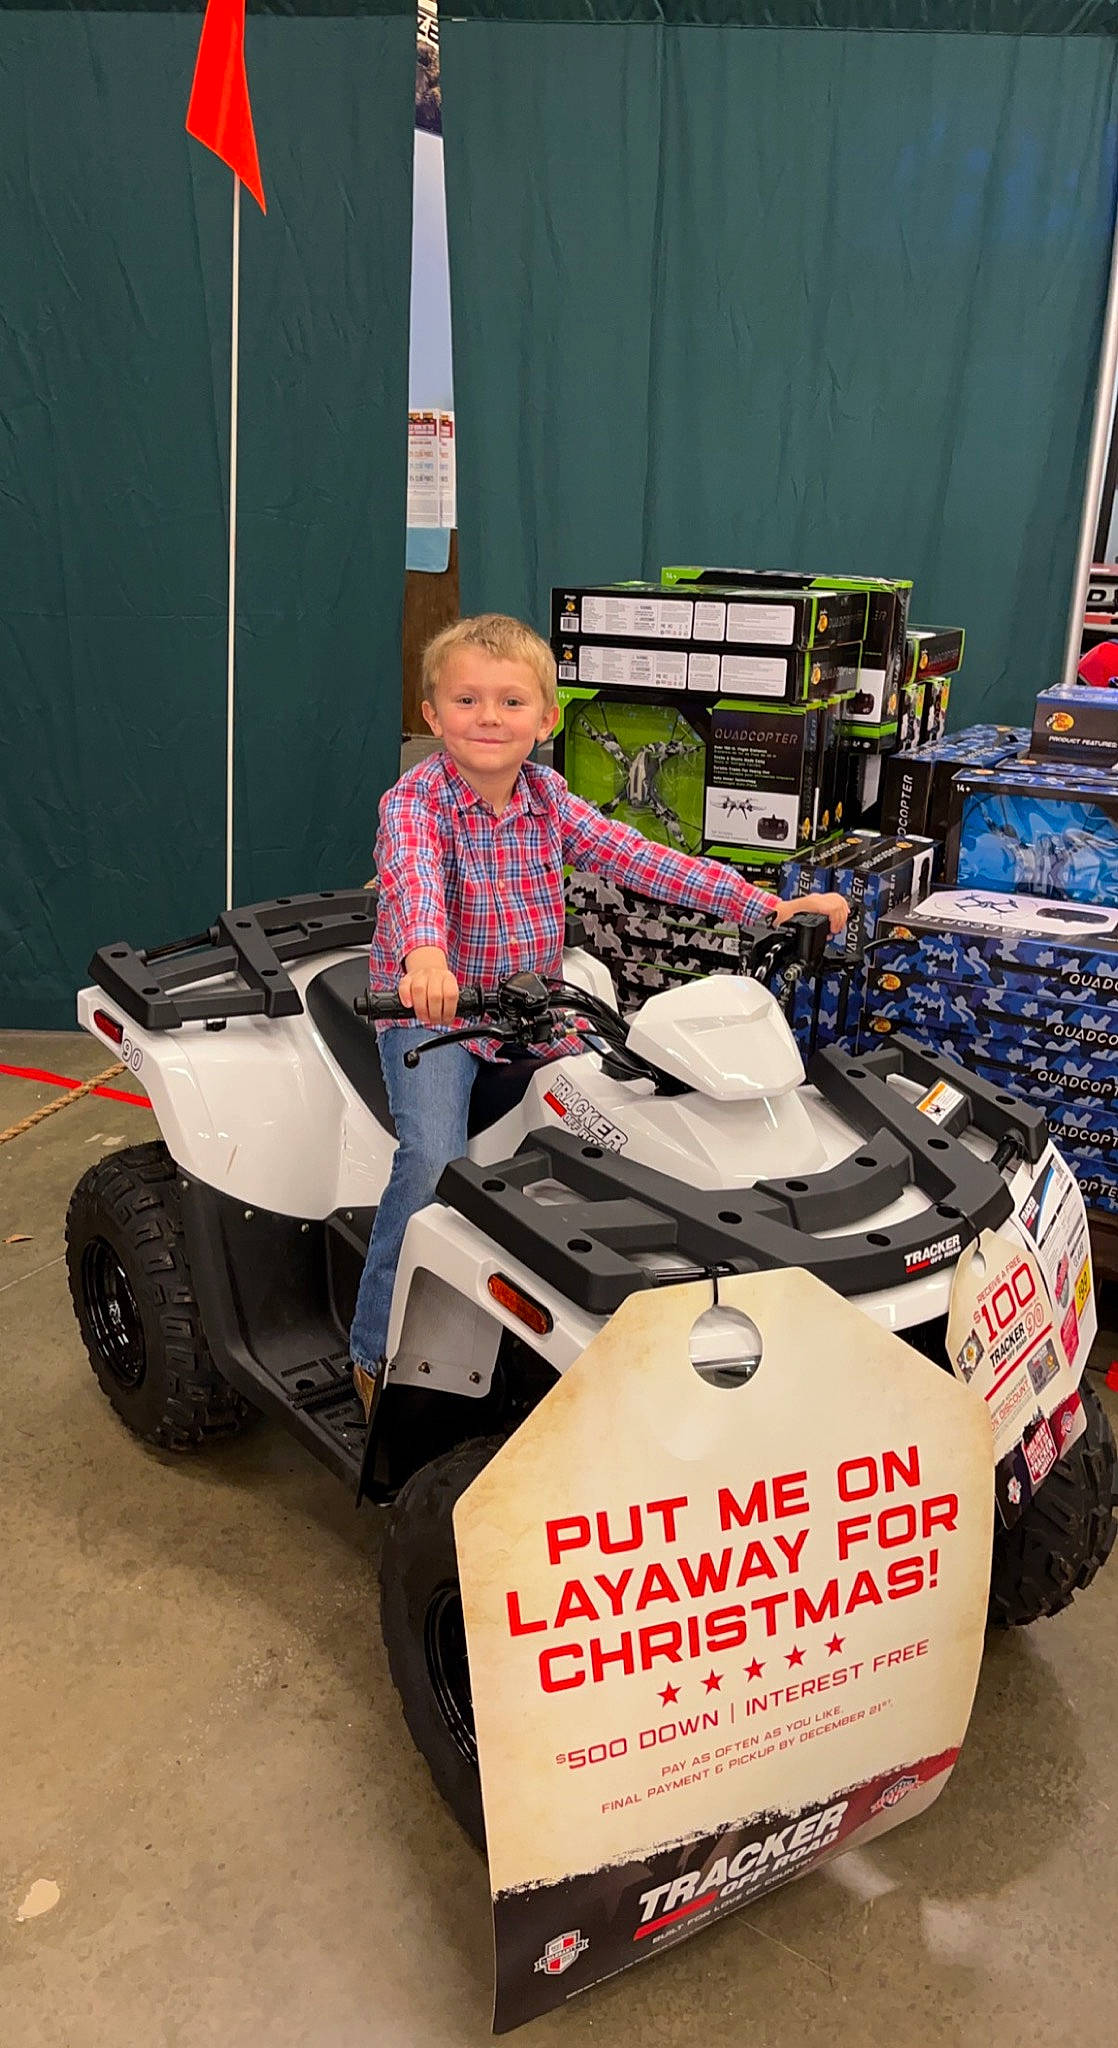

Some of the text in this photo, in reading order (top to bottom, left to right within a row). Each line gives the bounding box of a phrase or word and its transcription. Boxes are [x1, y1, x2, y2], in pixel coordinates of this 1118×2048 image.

[714, 728, 798, 744] QUADCOPTER
[1048, 736, 1081, 745] PRODUCT
[956, 784, 970, 793] 14+
[122, 1038, 144, 1071] 90
[1053, 1024, 1118, 1046] QUADCO
[550, 1074, 628, 1154] TRACKER
[1046, 1121, 1118, 1147] UADCOPT
[904, 1234, 960, 1266] TRACKER
[930, 1246, 961, 1264] OFF ROAD
[976, 1255, 1021, 1304] RECEIVE A FREE
[973, 1263, 1036, 1343] $100
[989, 1322, 1026, 1368] TRACKER
[1025, 1302, 1044, 1337] 90
[1015, 1336, 1027, 1351] ROAD
[1000, 1380, 1029, 1420] DISCOUNT
[545, 1445, 921, 1565] PUT ME ON
[506, 1493, 959, 1637] LAYAWAY FOR
[538, 1548, 940, 1694] CHRISTMAS!
[556, 1738, 627, 1770] $500
[639, 1710, 718, 1750] DOWN
[746, 1662, 864, 1717] INTEREST
[873, 1638, 929, 1673] FREE
[602, 1794, 642, 1814] FINAL
[647, 1769, 710, 1798] PAYMENT
[728, 1745, 775, 1769] PICKUP
[779, 1737, 795, 1750] BY
[800, 1710, 865, 1742] DECEMBER
[661, 1705, 844, 1777] PAY AS OFTEN AS YOU LIKE.
[638, 1801, 849, 1923] TRACKER
[720, 1830, 840, 1897] OFF ROAD
[652, 1856, 814, 1944] BUILT FOR LOVE OF COUNTRY
